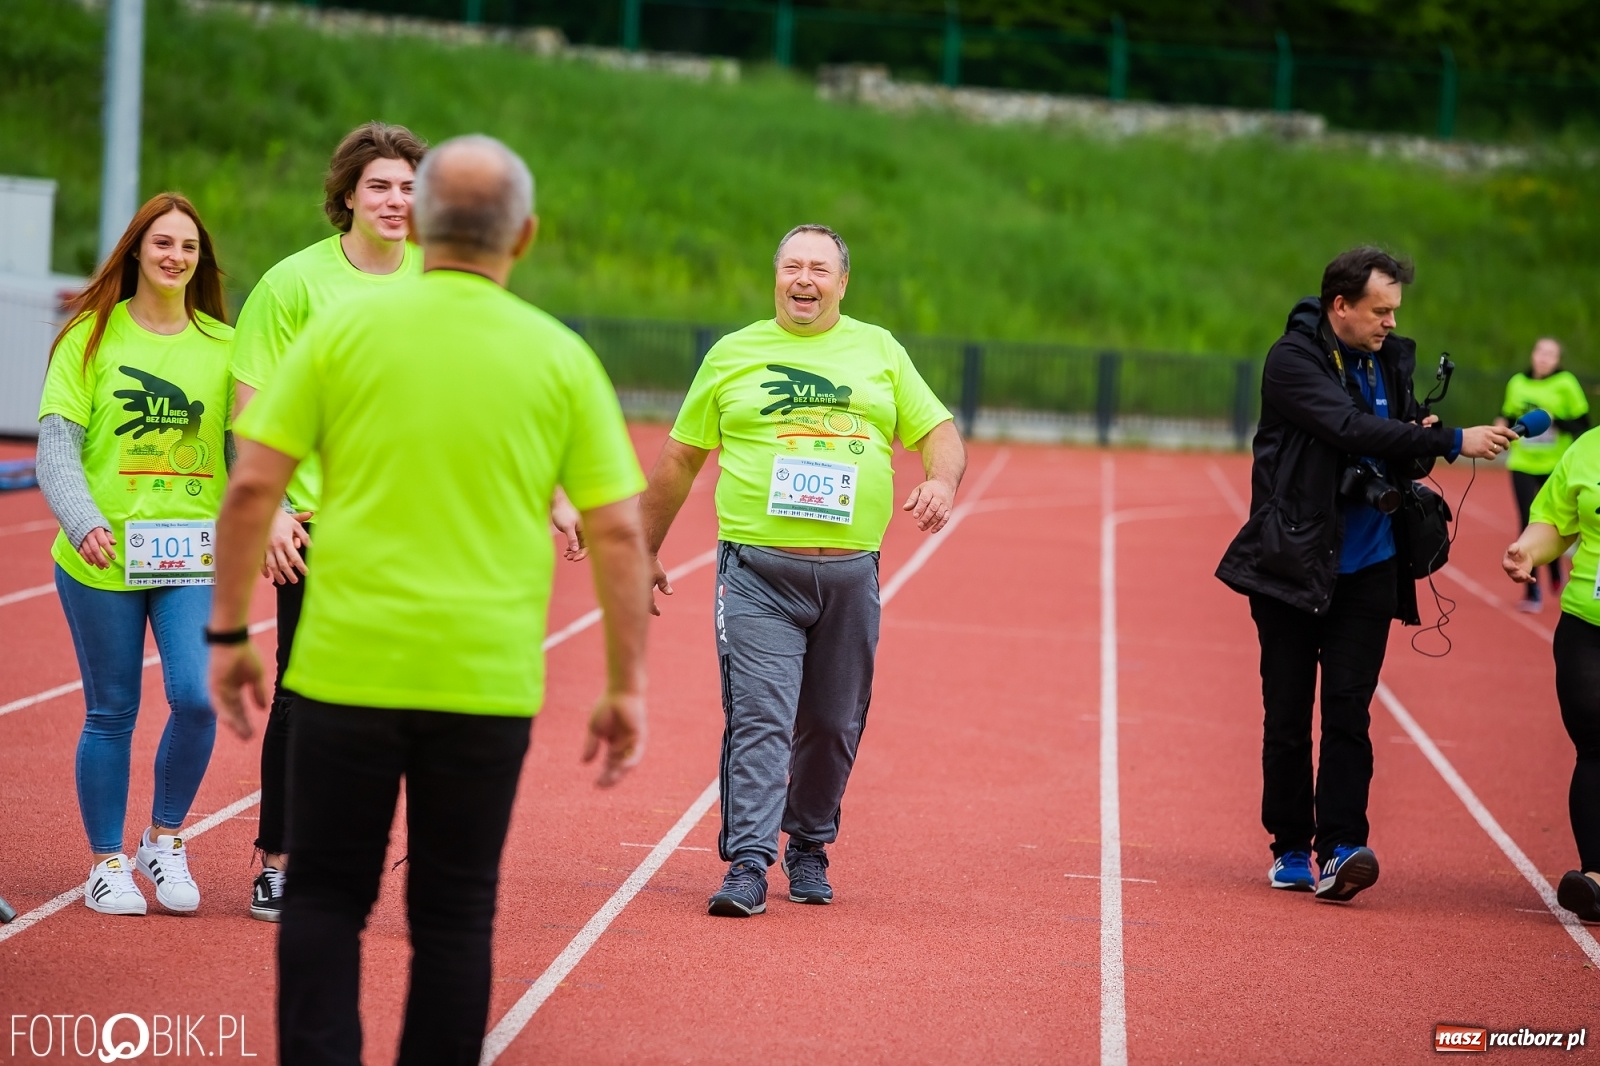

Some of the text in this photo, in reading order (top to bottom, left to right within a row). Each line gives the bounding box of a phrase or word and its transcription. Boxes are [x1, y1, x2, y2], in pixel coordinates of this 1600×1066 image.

[793, 385, 815, 396] VI
[146, 397, 188, 417] VI BIEG
[161, 416, 189, 424] BARIER
[793, 473, 834, 496] 005
[842, 474, 851, 485] R
[201, 531, 210, 542] R
[151, 537, 194, 558] 101
